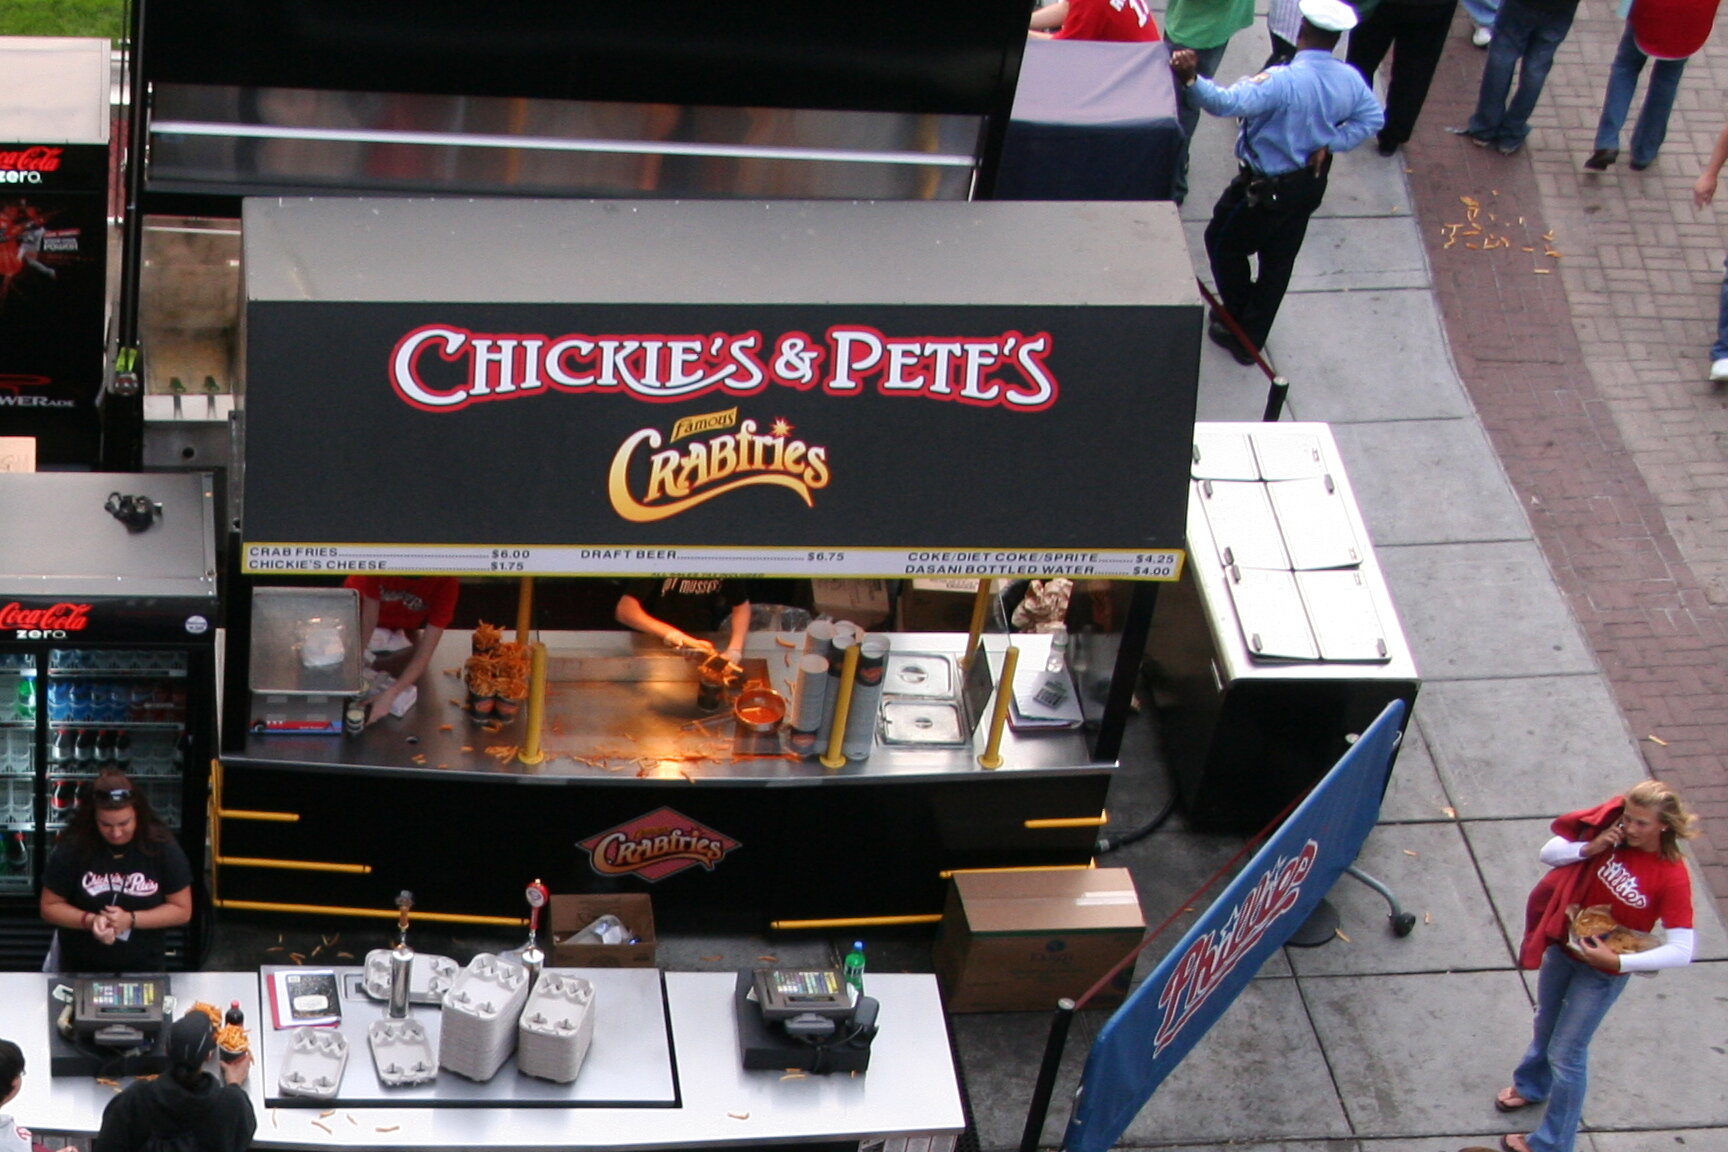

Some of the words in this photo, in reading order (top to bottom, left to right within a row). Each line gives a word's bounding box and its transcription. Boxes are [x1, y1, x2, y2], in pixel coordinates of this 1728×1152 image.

[391, 327, 765, 407] CHICKIE'S
[776, 338, 818, 385] &
[826, 329, 1055, 408] PETE'S
[249, 547, 292, 557] CRAB
[295, 547, 338, 557] FRIES
[491, 549, 530, 559] $6.00
[580, 549, 633, 559] DRAFT
[636, 550, 677, 560] BEER
[807, 552, 845, 562] $6.75
[907, 552, 990, 562] COKE/DIET
[994, 552, 1098, 563] COKE/SPRITE
[1135, 554, 1174, 564] $4.25
[249, 559, 322, 570] CHICKIE'S
[326, 560, 387, 570] CHEESE
[490, 561, 524, 571] $1.75
[905, 564, 962, 574] DASANI
[965, 564, 1037, 575] BOTTLED
[1041, 565, 1095, 575] WATER
[1133, 566, 1170, 576] $4.00
[16, 629, 67, 639] zero
[1152, 838, 1318, 1060] Phillies
